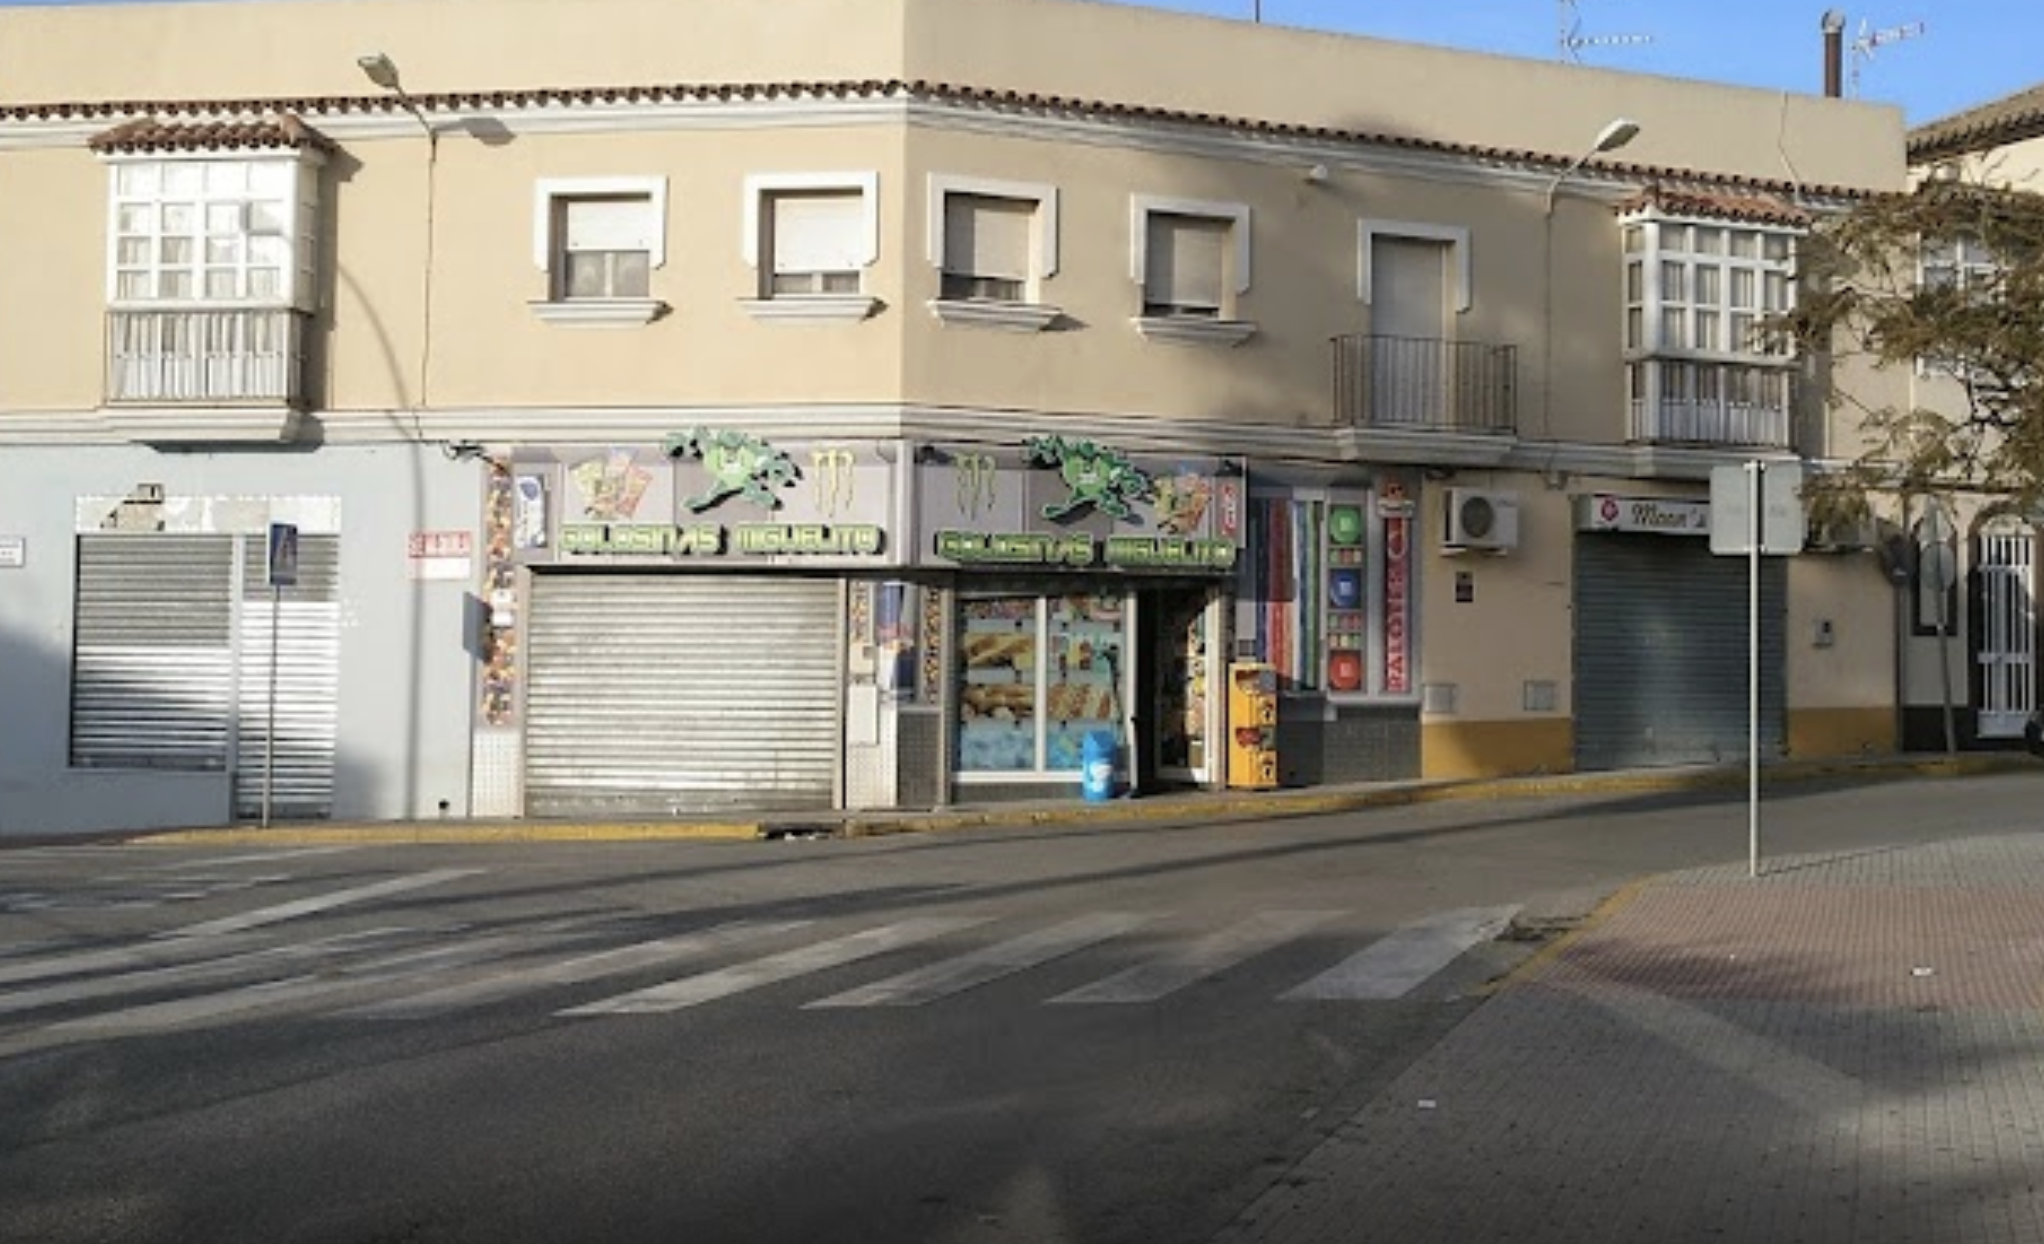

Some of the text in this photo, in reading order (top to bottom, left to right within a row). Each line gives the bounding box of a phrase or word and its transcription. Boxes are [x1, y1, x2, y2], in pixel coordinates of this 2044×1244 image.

[560, 523, 882, 553] GOLOSINAS MIGUELITO
[936, 531, 1093, 566] GOLOSINAS
